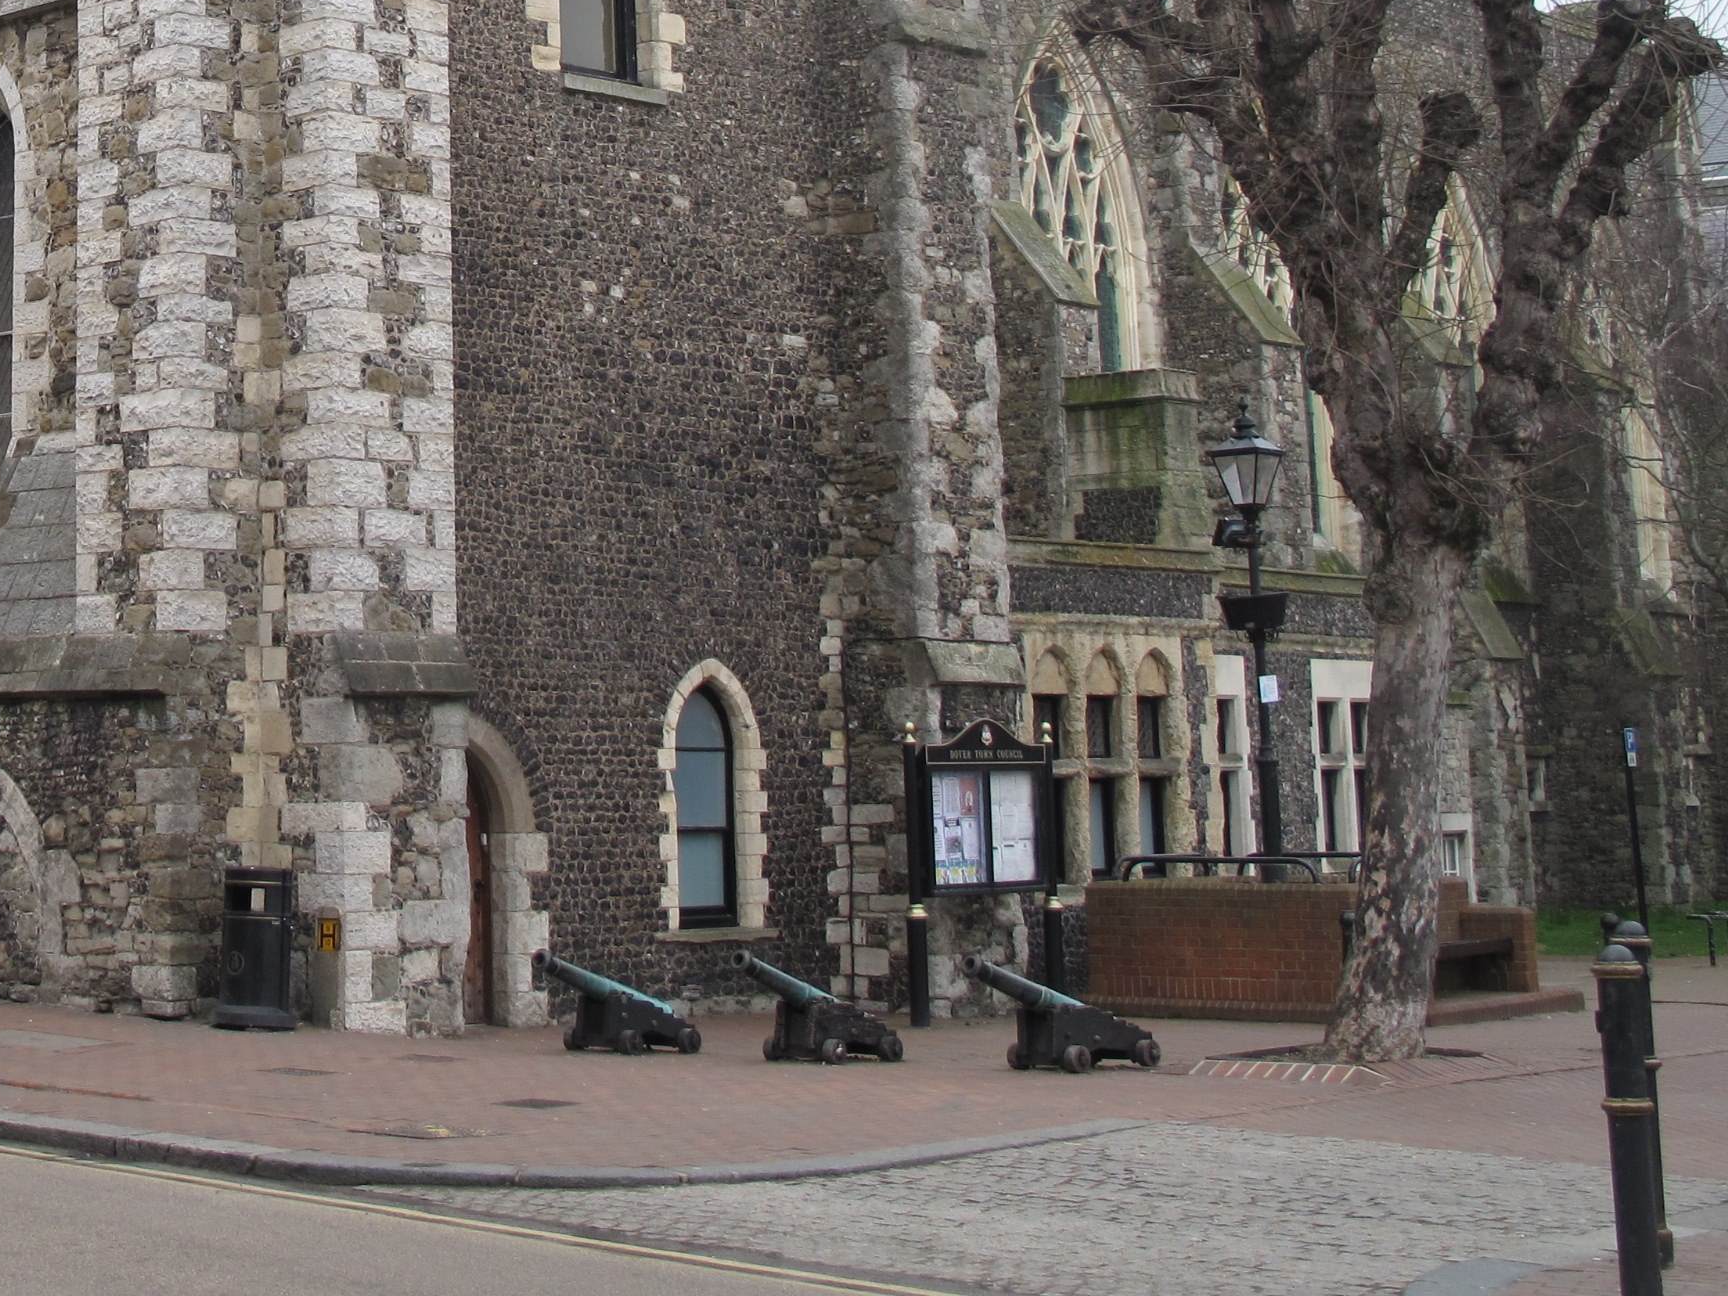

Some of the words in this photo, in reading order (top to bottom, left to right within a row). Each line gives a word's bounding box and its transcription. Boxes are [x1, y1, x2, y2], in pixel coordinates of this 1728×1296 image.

[949, 749, 971, 759] DOVER
[975, 749, 993, 759] TOWN
[996, 749, 1024, 759] COUNCIL
[320, 922, 336, 949] H
